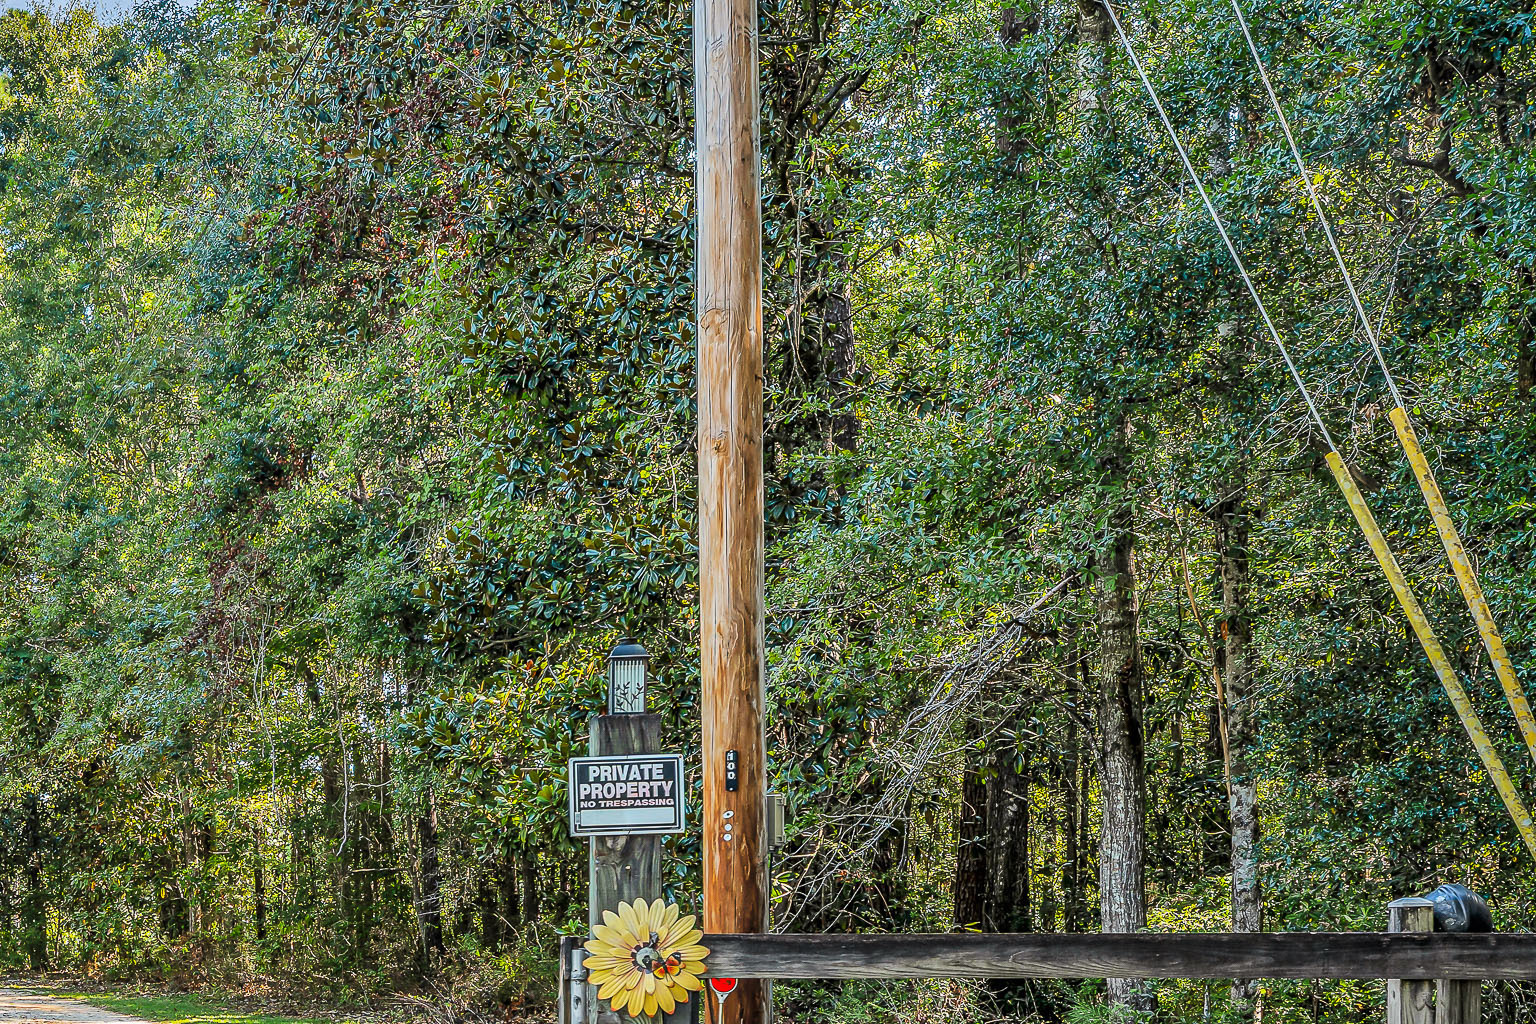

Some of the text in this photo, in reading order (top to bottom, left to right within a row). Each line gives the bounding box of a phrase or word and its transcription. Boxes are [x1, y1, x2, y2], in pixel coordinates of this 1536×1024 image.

[589, 764, 664, 782] PRIVATE
[579, 781, 674, 800] PROPERTY
[599, 798, 674, 807] TRESPASSING
